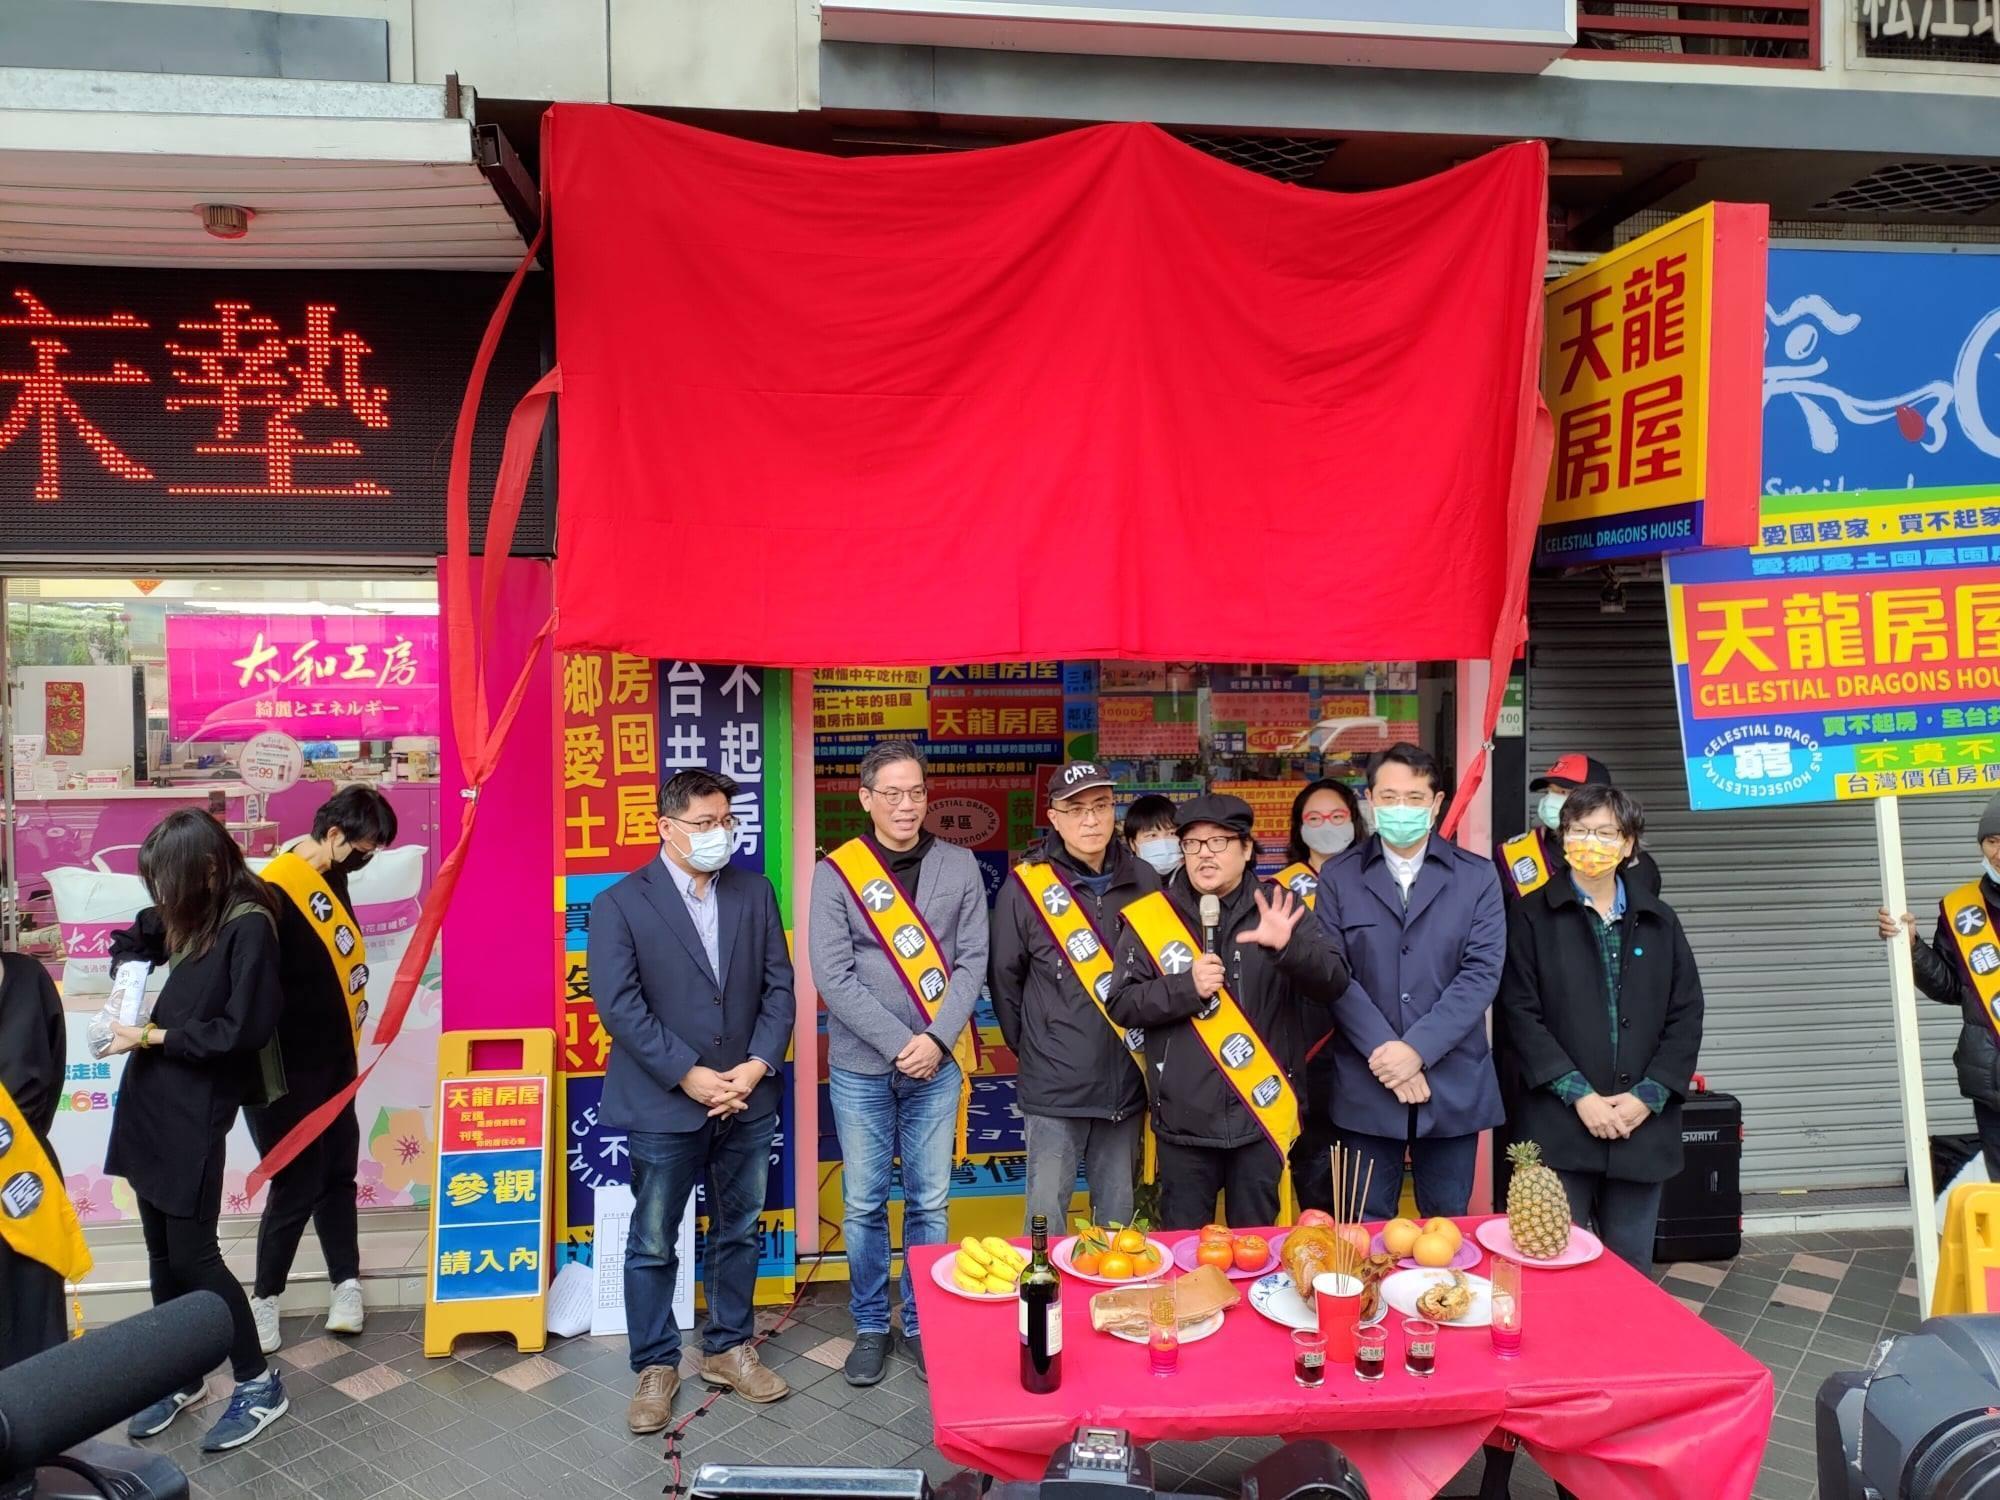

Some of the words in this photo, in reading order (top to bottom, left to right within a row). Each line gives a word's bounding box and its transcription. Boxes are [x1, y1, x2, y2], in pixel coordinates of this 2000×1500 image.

[0, 290, 391, 499] 床墊
[1545, 528, 1595, 553] CELESTIAL
[1596, 522, 1648, 547] DRAGONS
[1650, 518, 1692, 541] HOUSE
[1697, 583, 2000, 676] 天龍房屋
[232, 631, 419, 690] 太和工房
[1700, 678, 1831, 707] CELESTIAL
[1837, 670, 1952, 699] DRAGONS
[255, 700, 400, 719] 綺麗とエネルギー
[936, 708, 1058, 735] 天龍房屋
[1704, 723, 1770, 758] CELESTIAL
[1775, 724, 1823, 773] DRAGONS
[1064, 765, 1097, 785] CATS
[448, 1085, 540, 1109] 天龍房屋
[446, 1169, 536, 1208] 參觀
[440, 1246, 538, 1276] 請入內
